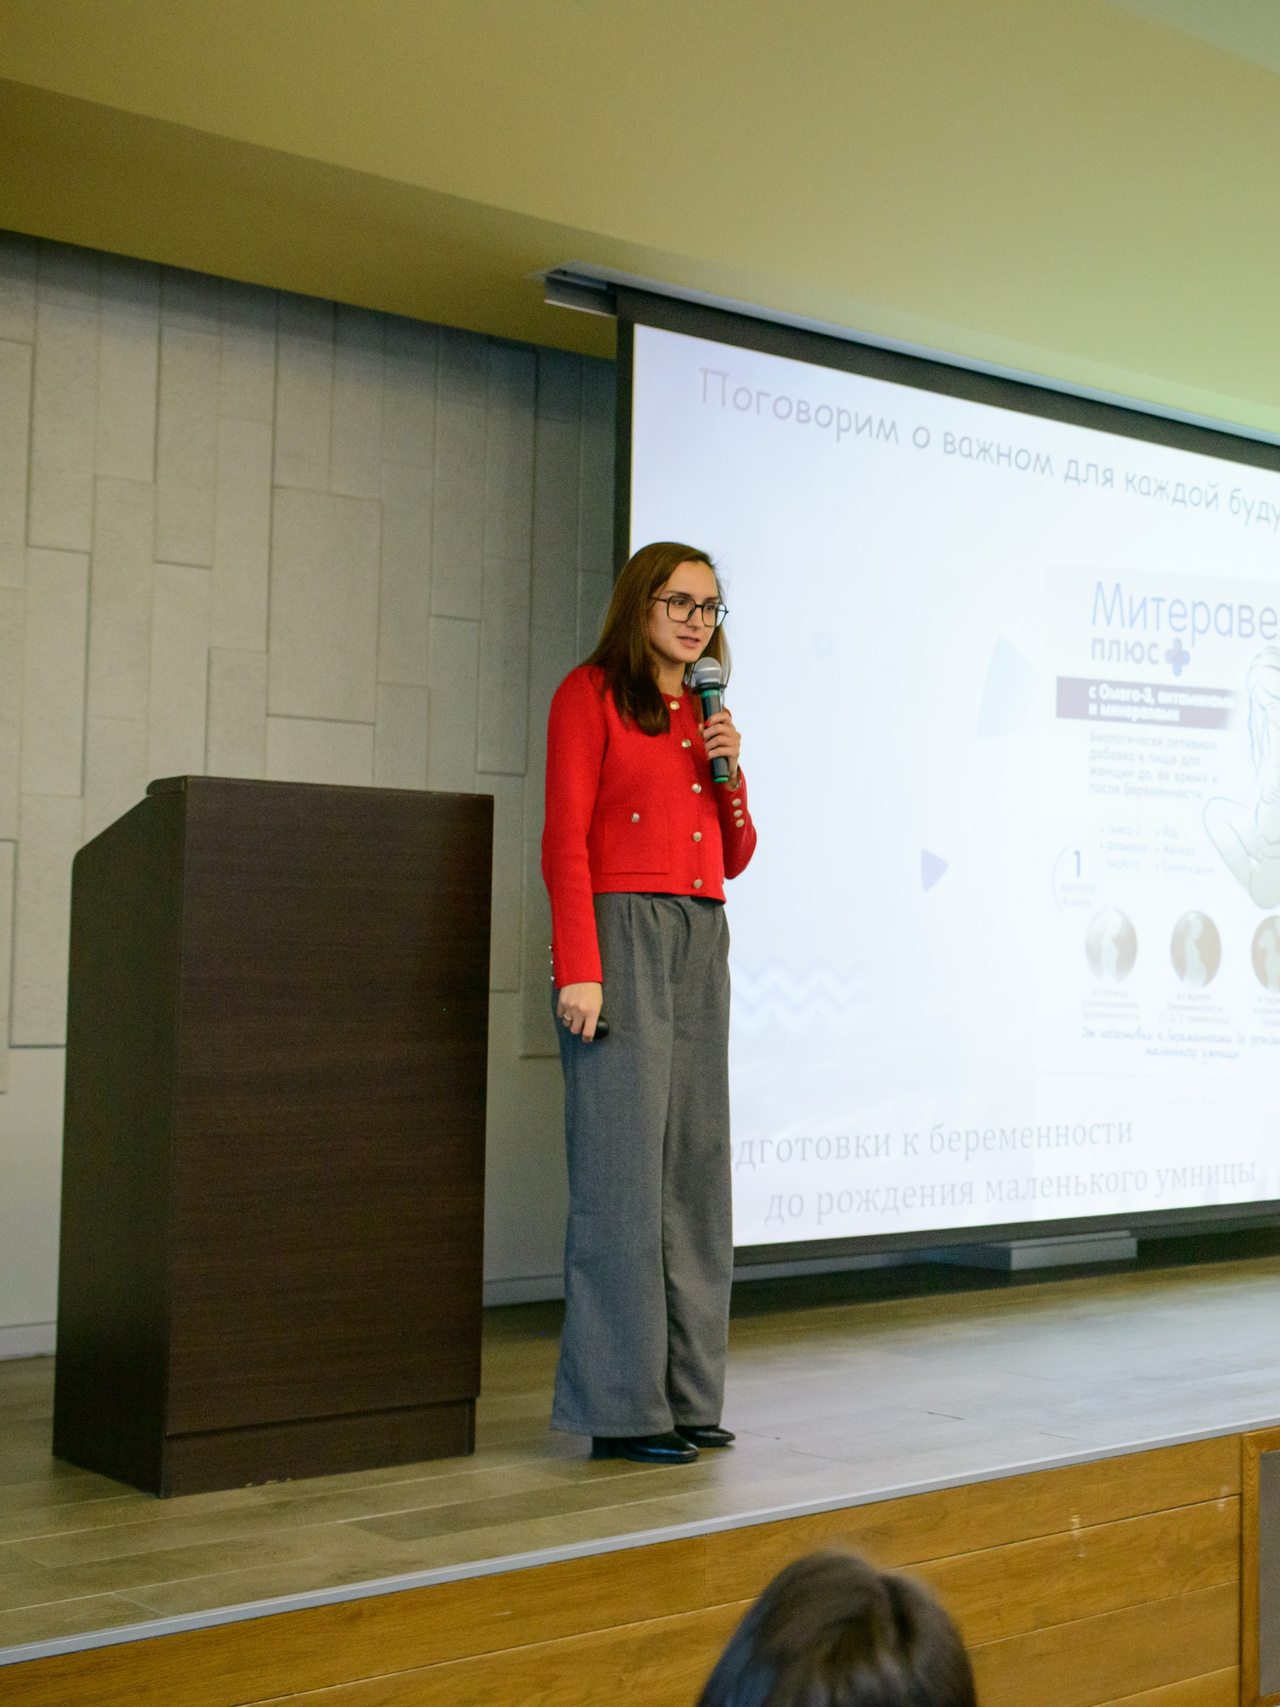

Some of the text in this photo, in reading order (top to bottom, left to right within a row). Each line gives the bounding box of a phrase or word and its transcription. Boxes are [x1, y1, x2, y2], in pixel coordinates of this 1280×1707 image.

[699, 366, 900, 443] Поговорим
[911, 426, 931, 449] о
[943, 430, 1055, 477] важном
[1063, 457, 1115, 489] для
[1124, 469, 1220, 511] каждой
[1090, 637, 1160, 666] плюс
[902, 1131, 920, 1156] к
[928, 1120, 1134, 1162] беременности
[764, 1162, 1257, 1227] до рождения маленького умницы
